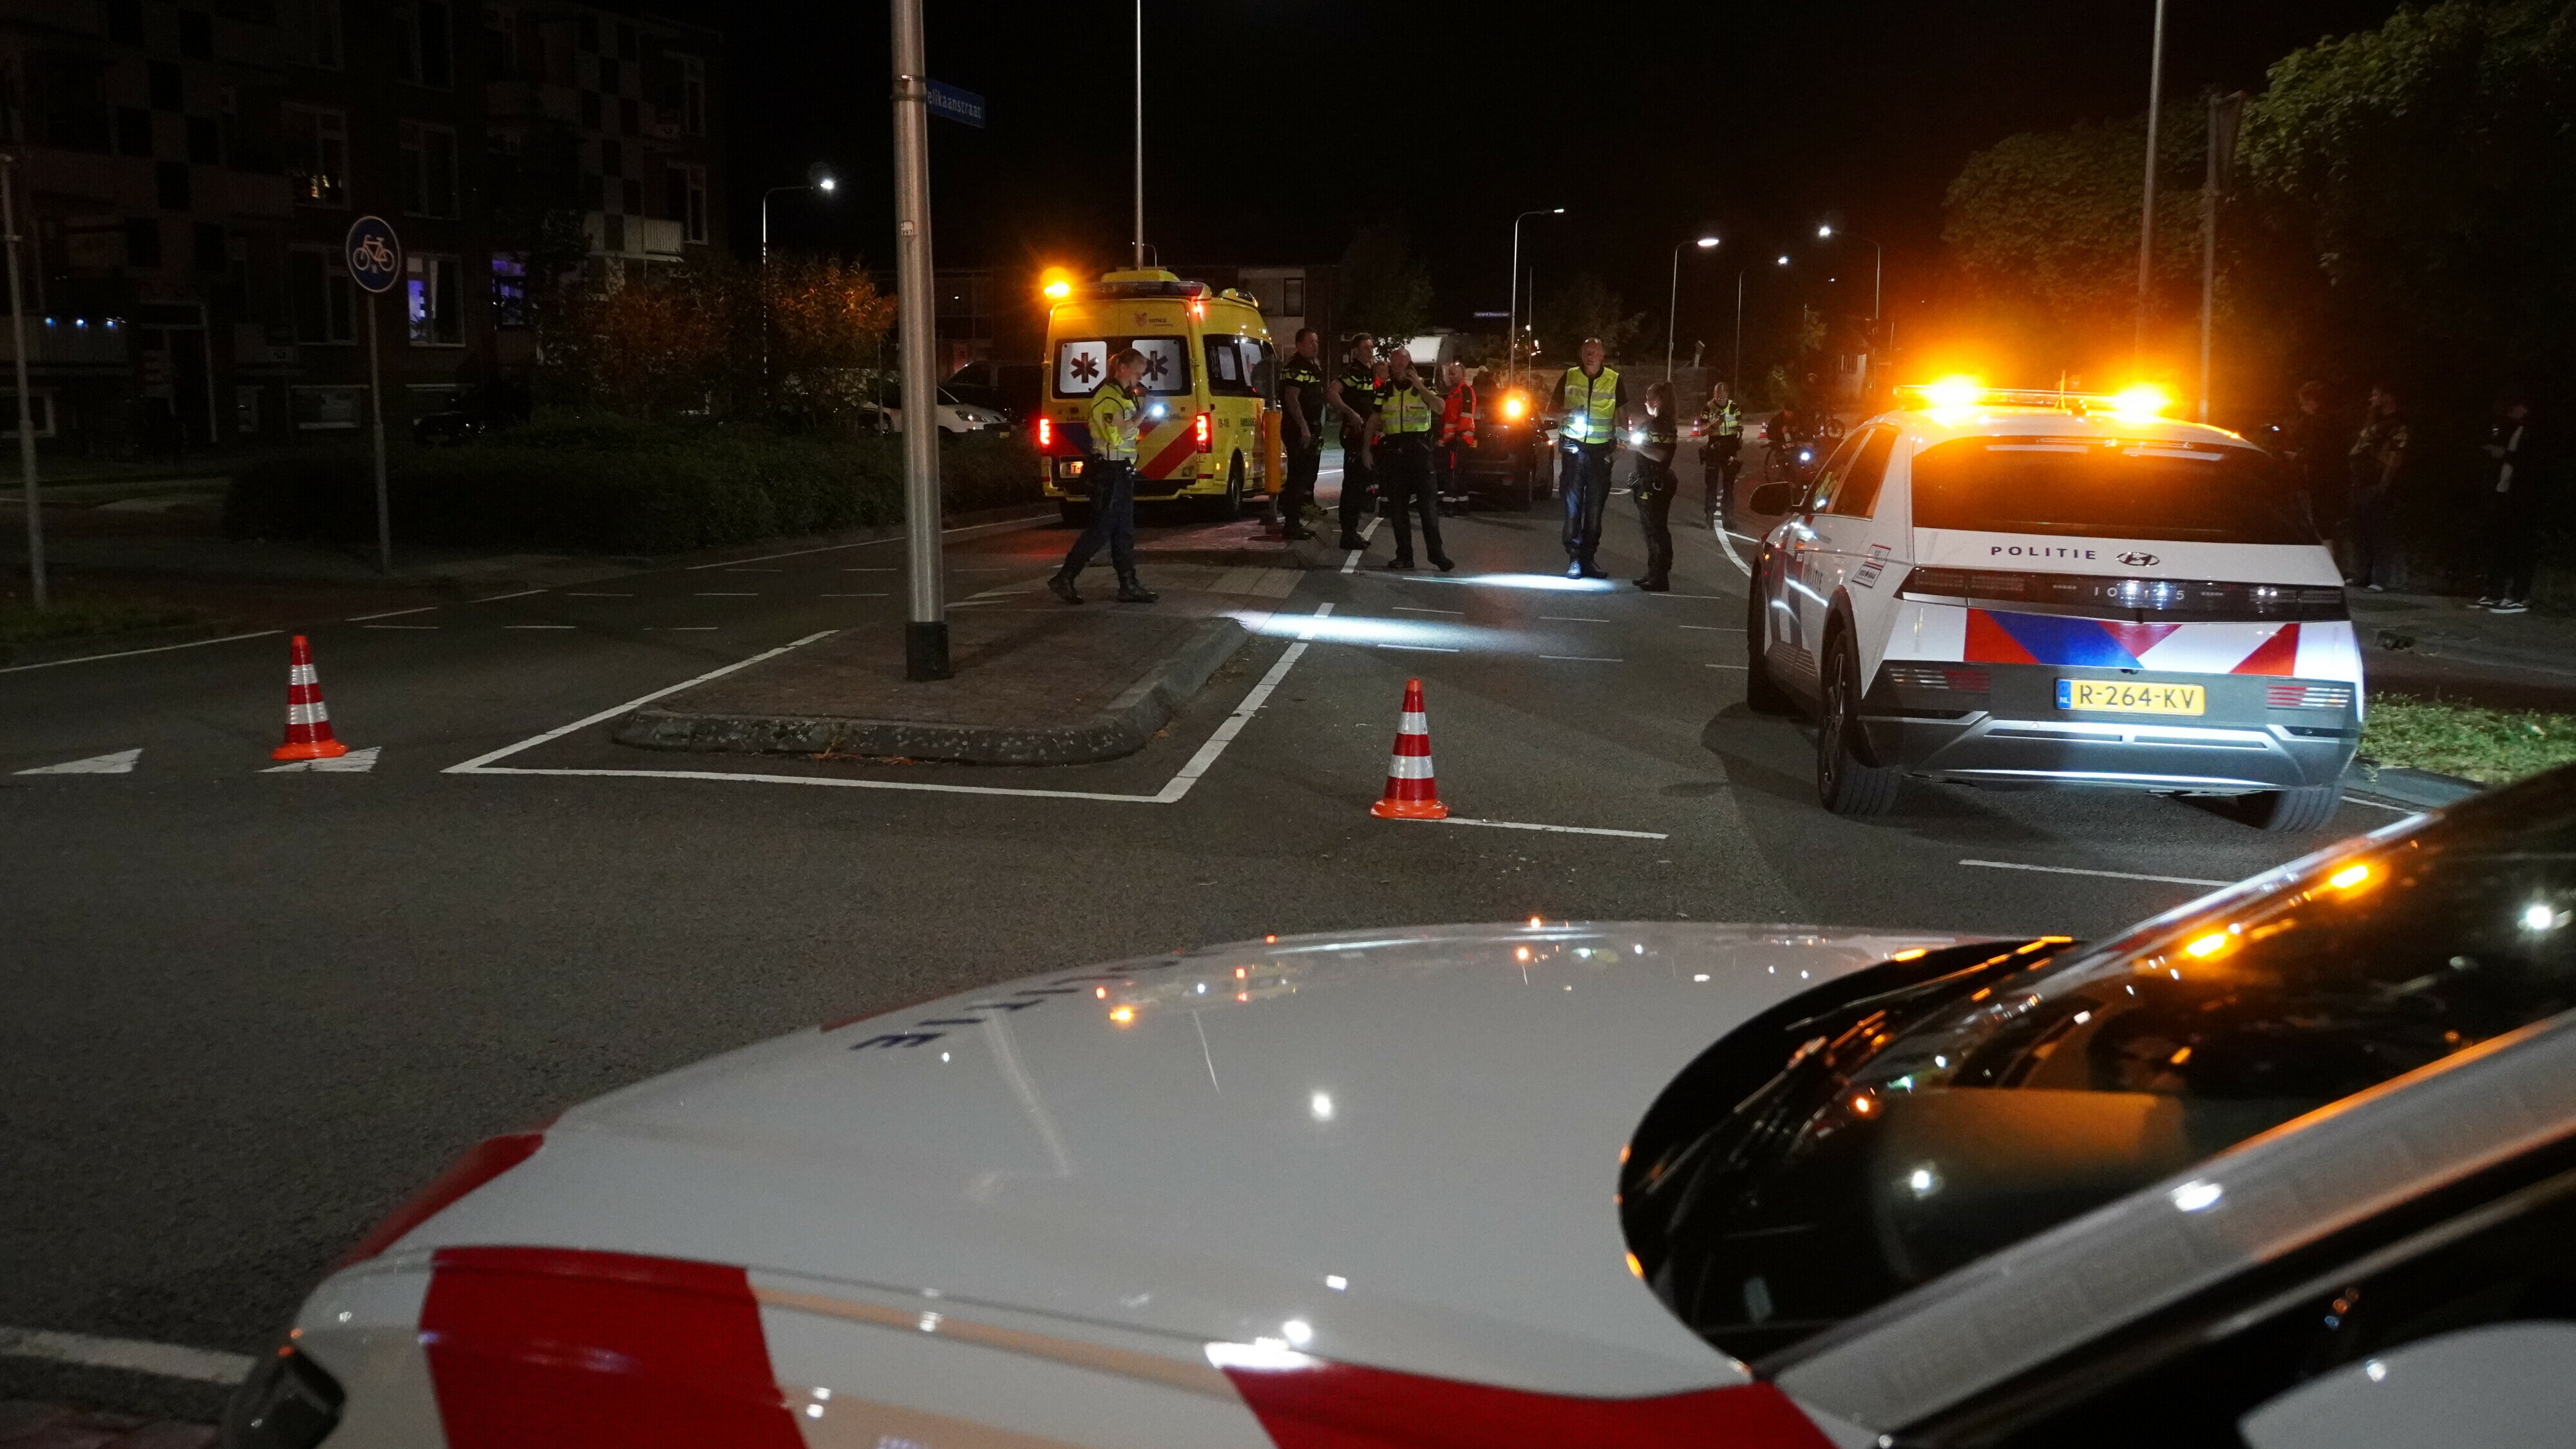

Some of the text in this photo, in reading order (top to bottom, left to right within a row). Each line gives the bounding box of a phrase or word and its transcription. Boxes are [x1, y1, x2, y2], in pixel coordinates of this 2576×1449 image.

[927, 89, 981, 118] elikaanstraat
[1991, 546, 2096, 560] POLITIE
[2079, 685, 2194, 709] R-264-KV
